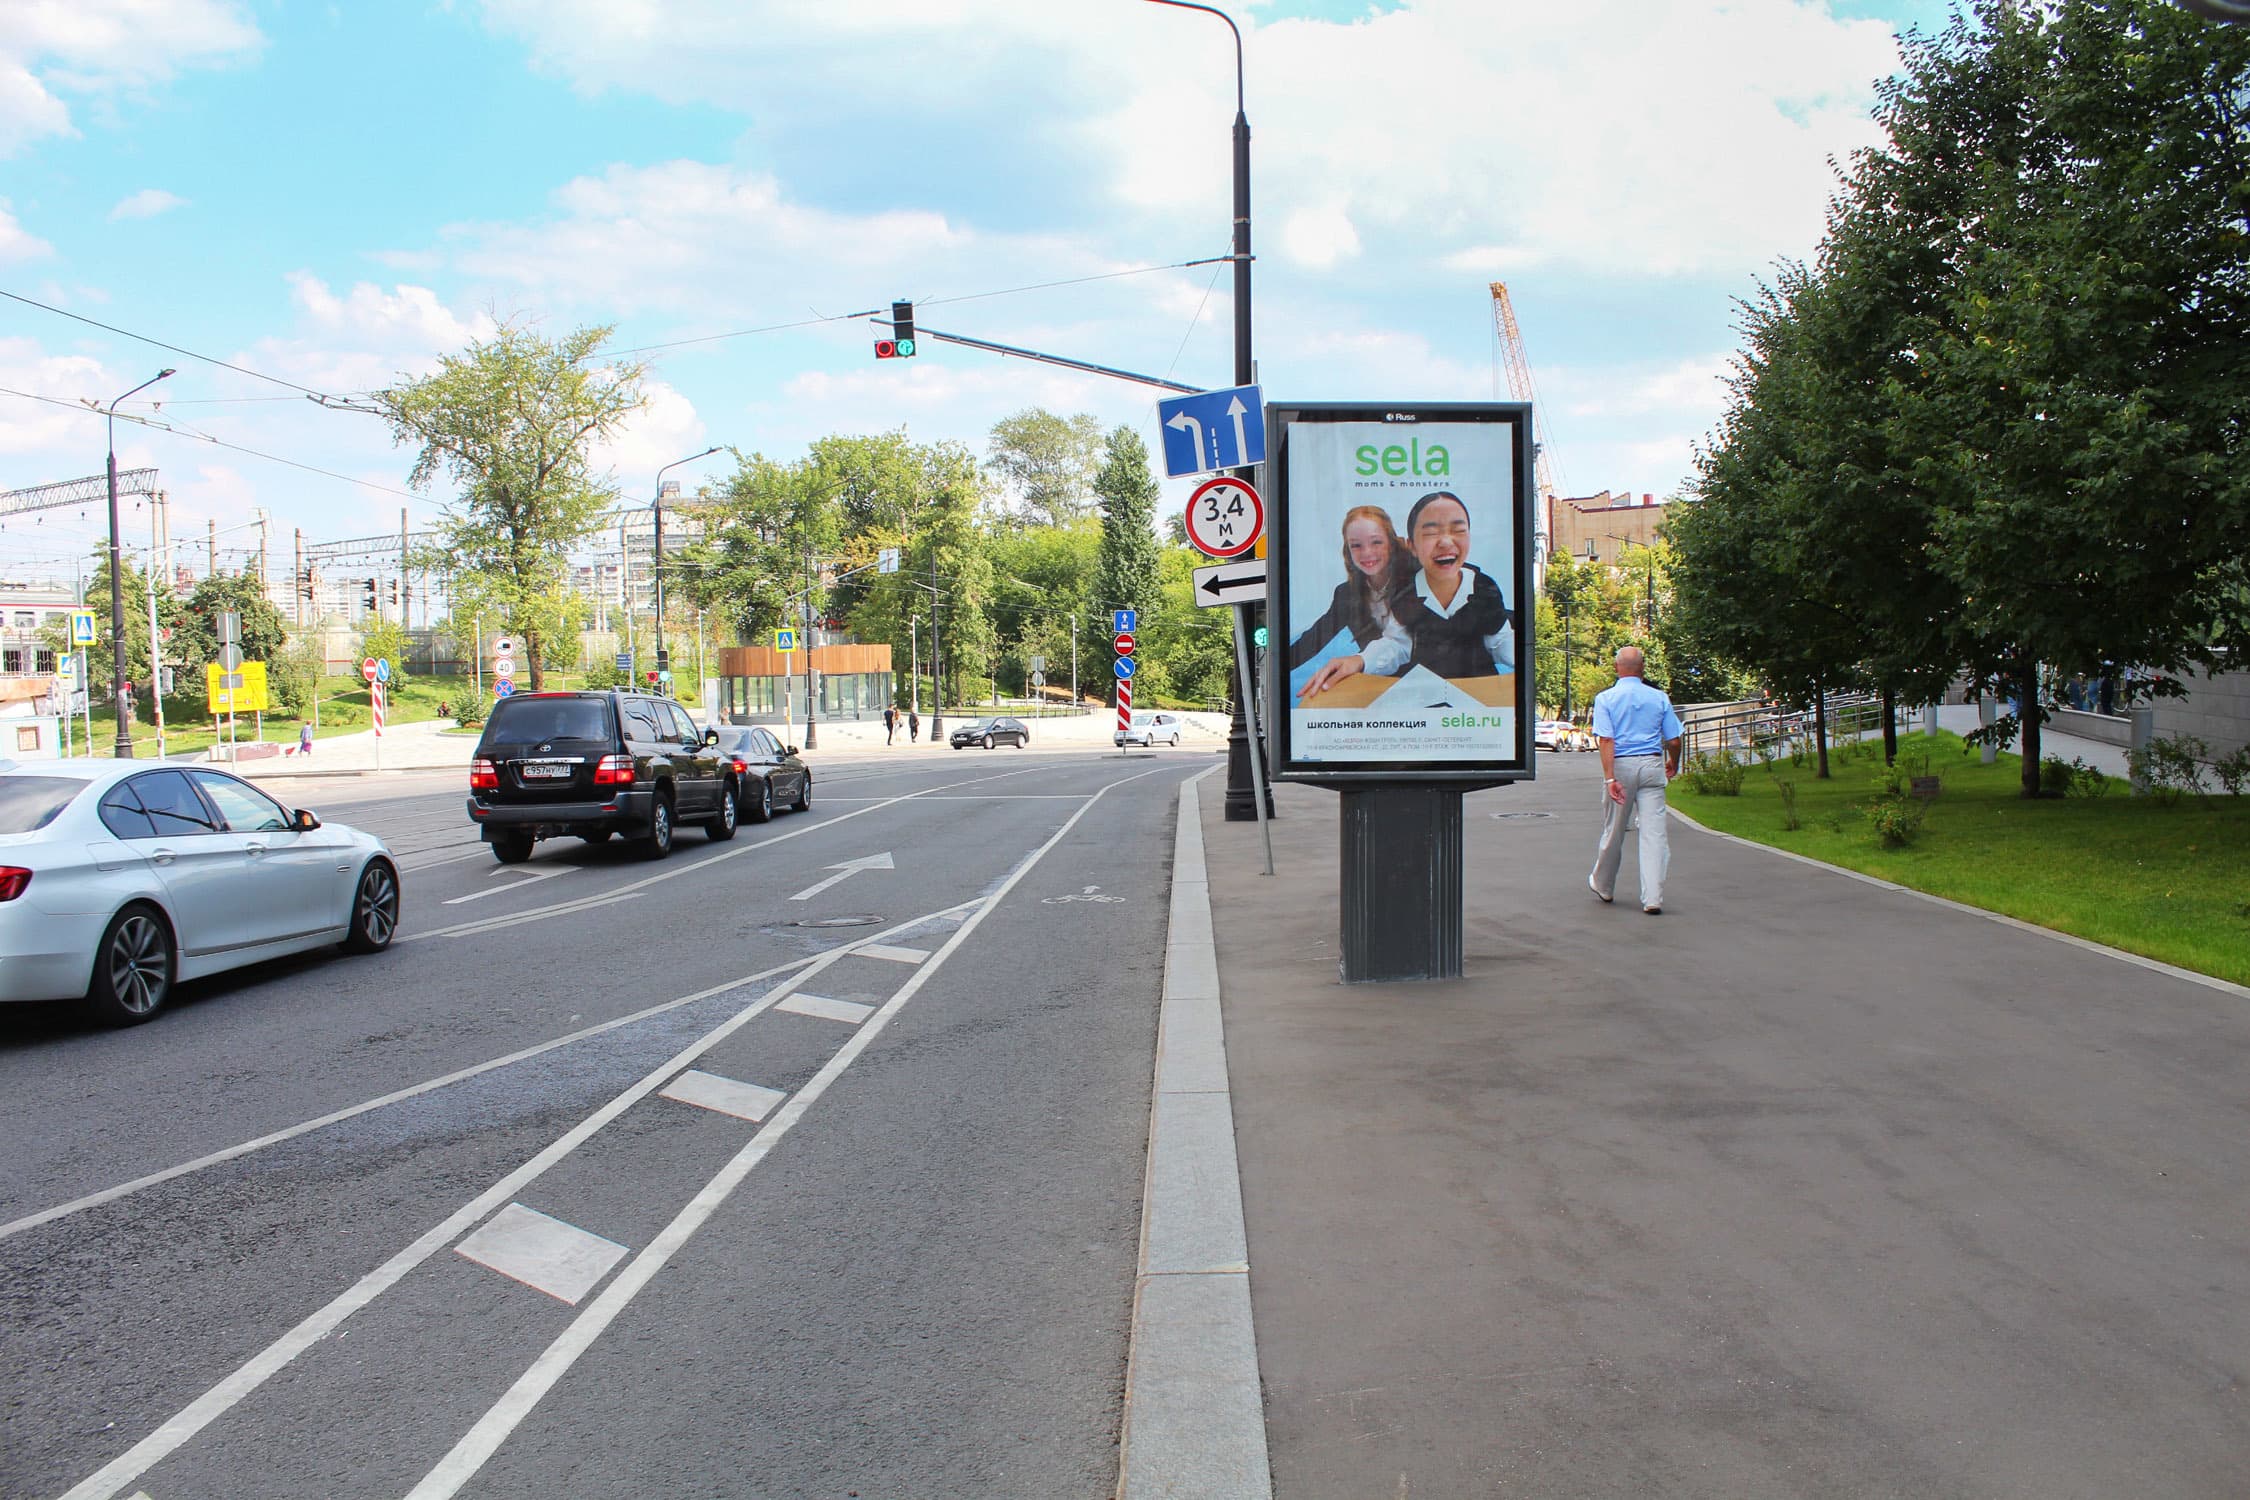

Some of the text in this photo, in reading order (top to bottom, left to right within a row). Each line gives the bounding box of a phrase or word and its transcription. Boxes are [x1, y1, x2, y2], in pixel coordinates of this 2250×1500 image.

[1395, 413, 1416, 421] Russ
[1355, 437, 1450, 476] sela
[1204, 493, 1244, 522] 3,4
[499, 663, 510, 672] 40
[1307, 719, 1427, 730] школьная коллекция
[1441, 713, 1502, 728] sela.ru
